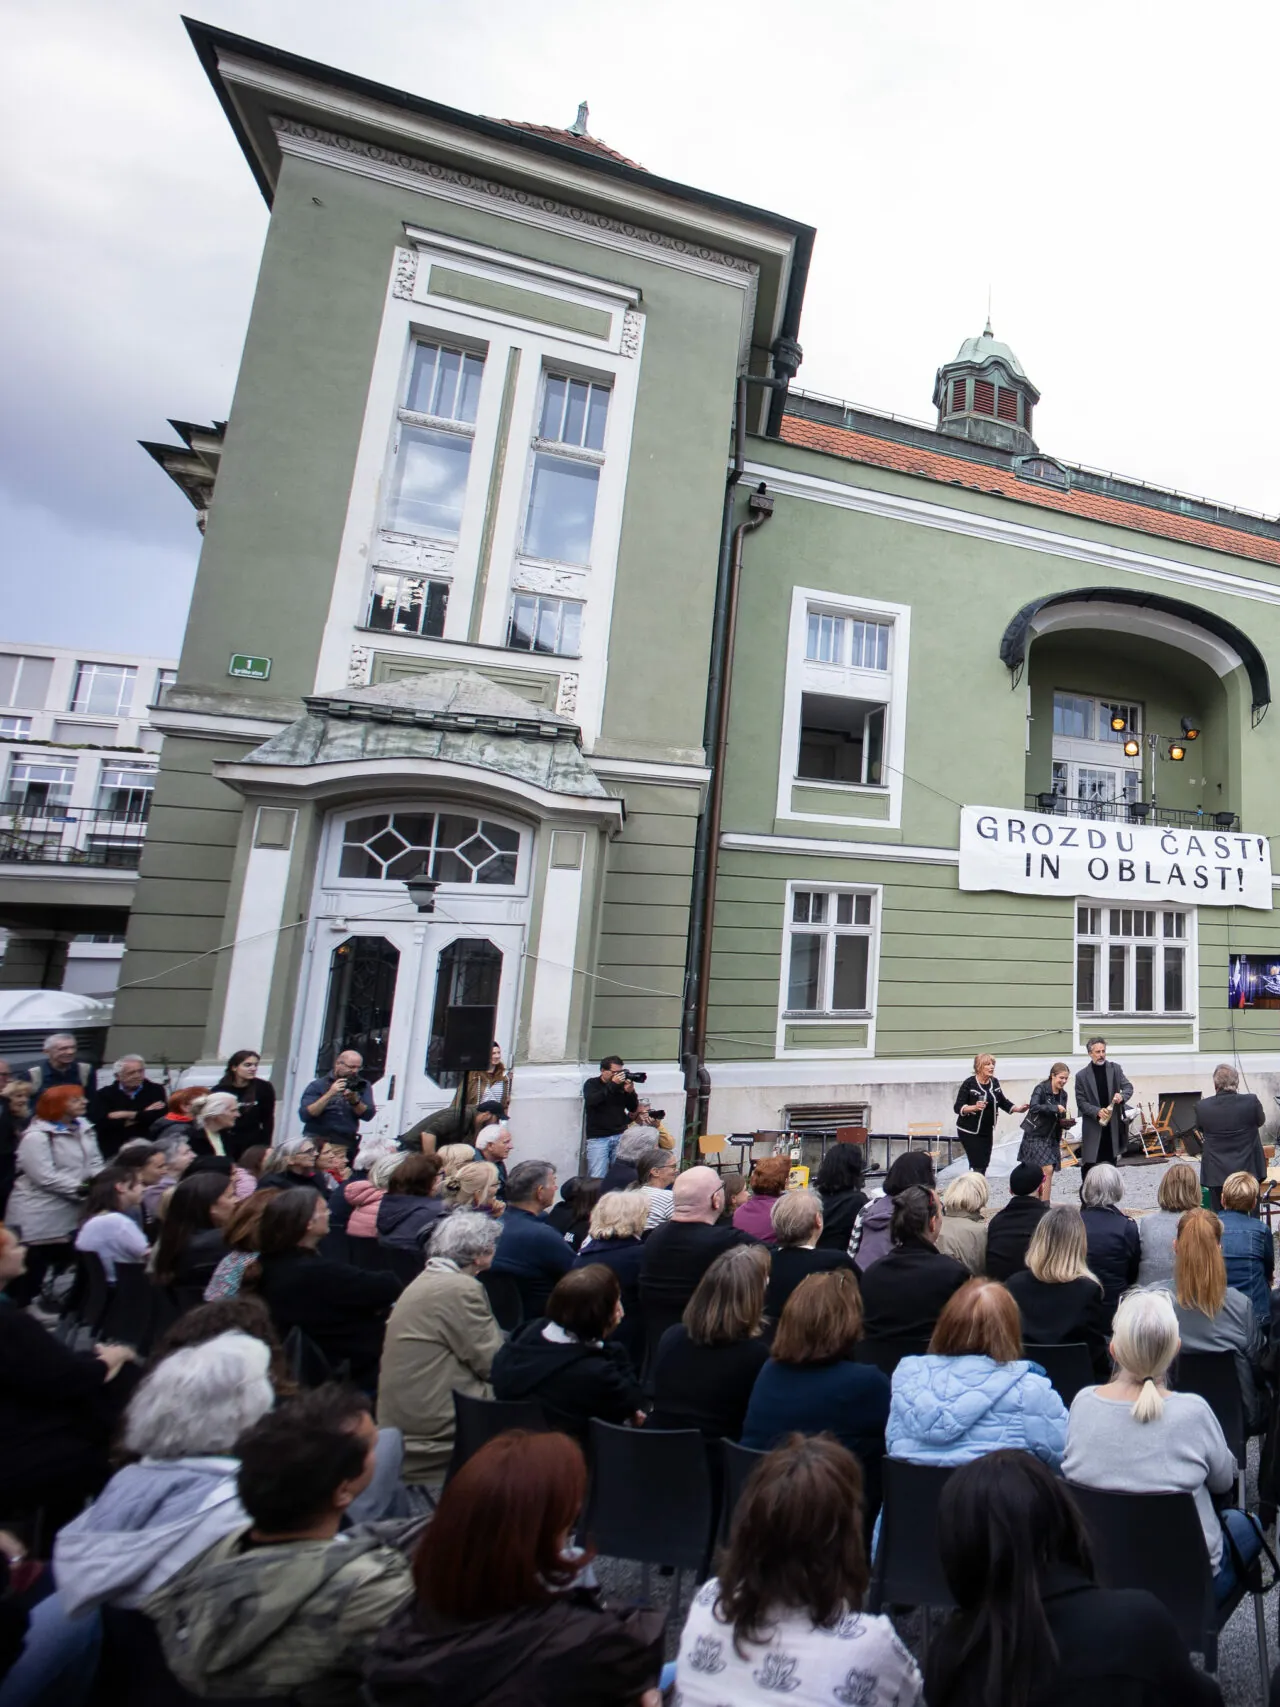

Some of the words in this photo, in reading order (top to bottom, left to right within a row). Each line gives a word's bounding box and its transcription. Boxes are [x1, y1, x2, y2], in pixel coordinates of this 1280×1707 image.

[246, 659, 252, 670] 1
[976, 816, 1134, 852] GROZDU
[1160, 829, 1265, 862] ČAST!
[1025, 852, 1060, 879] IN
[1087, 857, 1245, 892] OBLAST!
